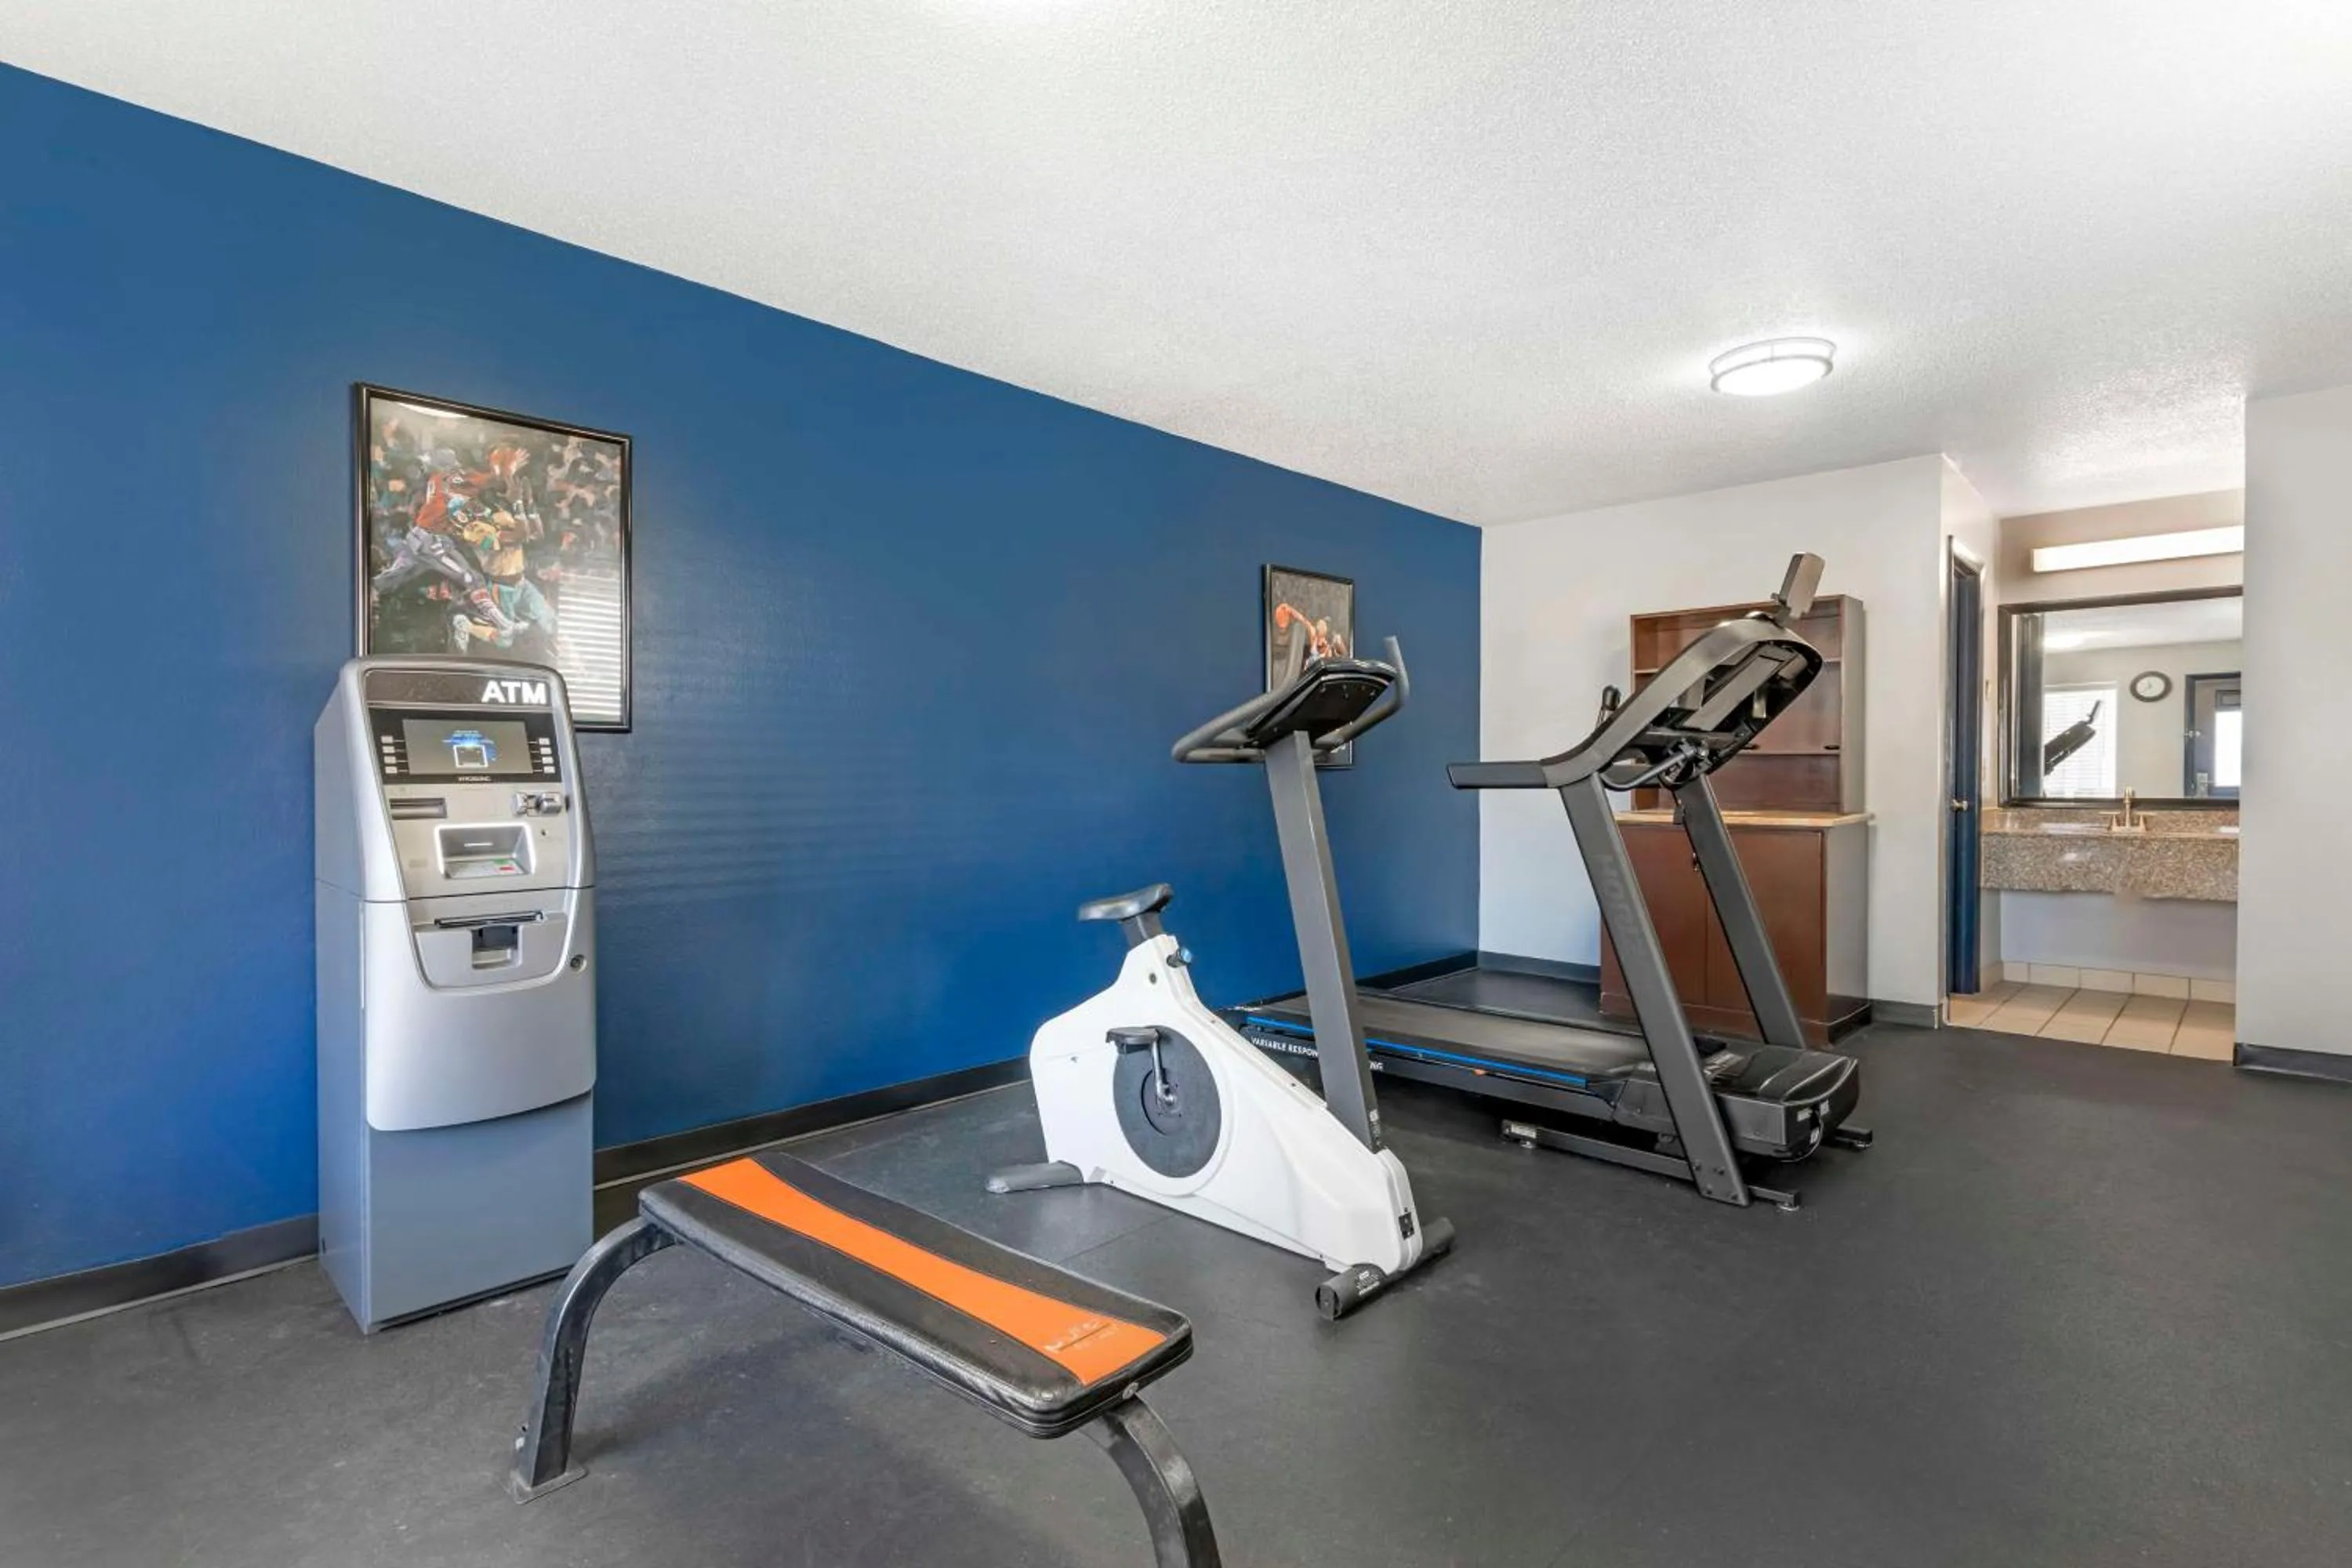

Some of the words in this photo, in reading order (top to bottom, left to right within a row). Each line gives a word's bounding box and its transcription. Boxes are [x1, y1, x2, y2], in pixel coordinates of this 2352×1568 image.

[481, 680, 546, 704] ATM
[1250, 1036, 1286, 1052] VARIABLE
[1288, 1044, 1318, 1058] RESPON
